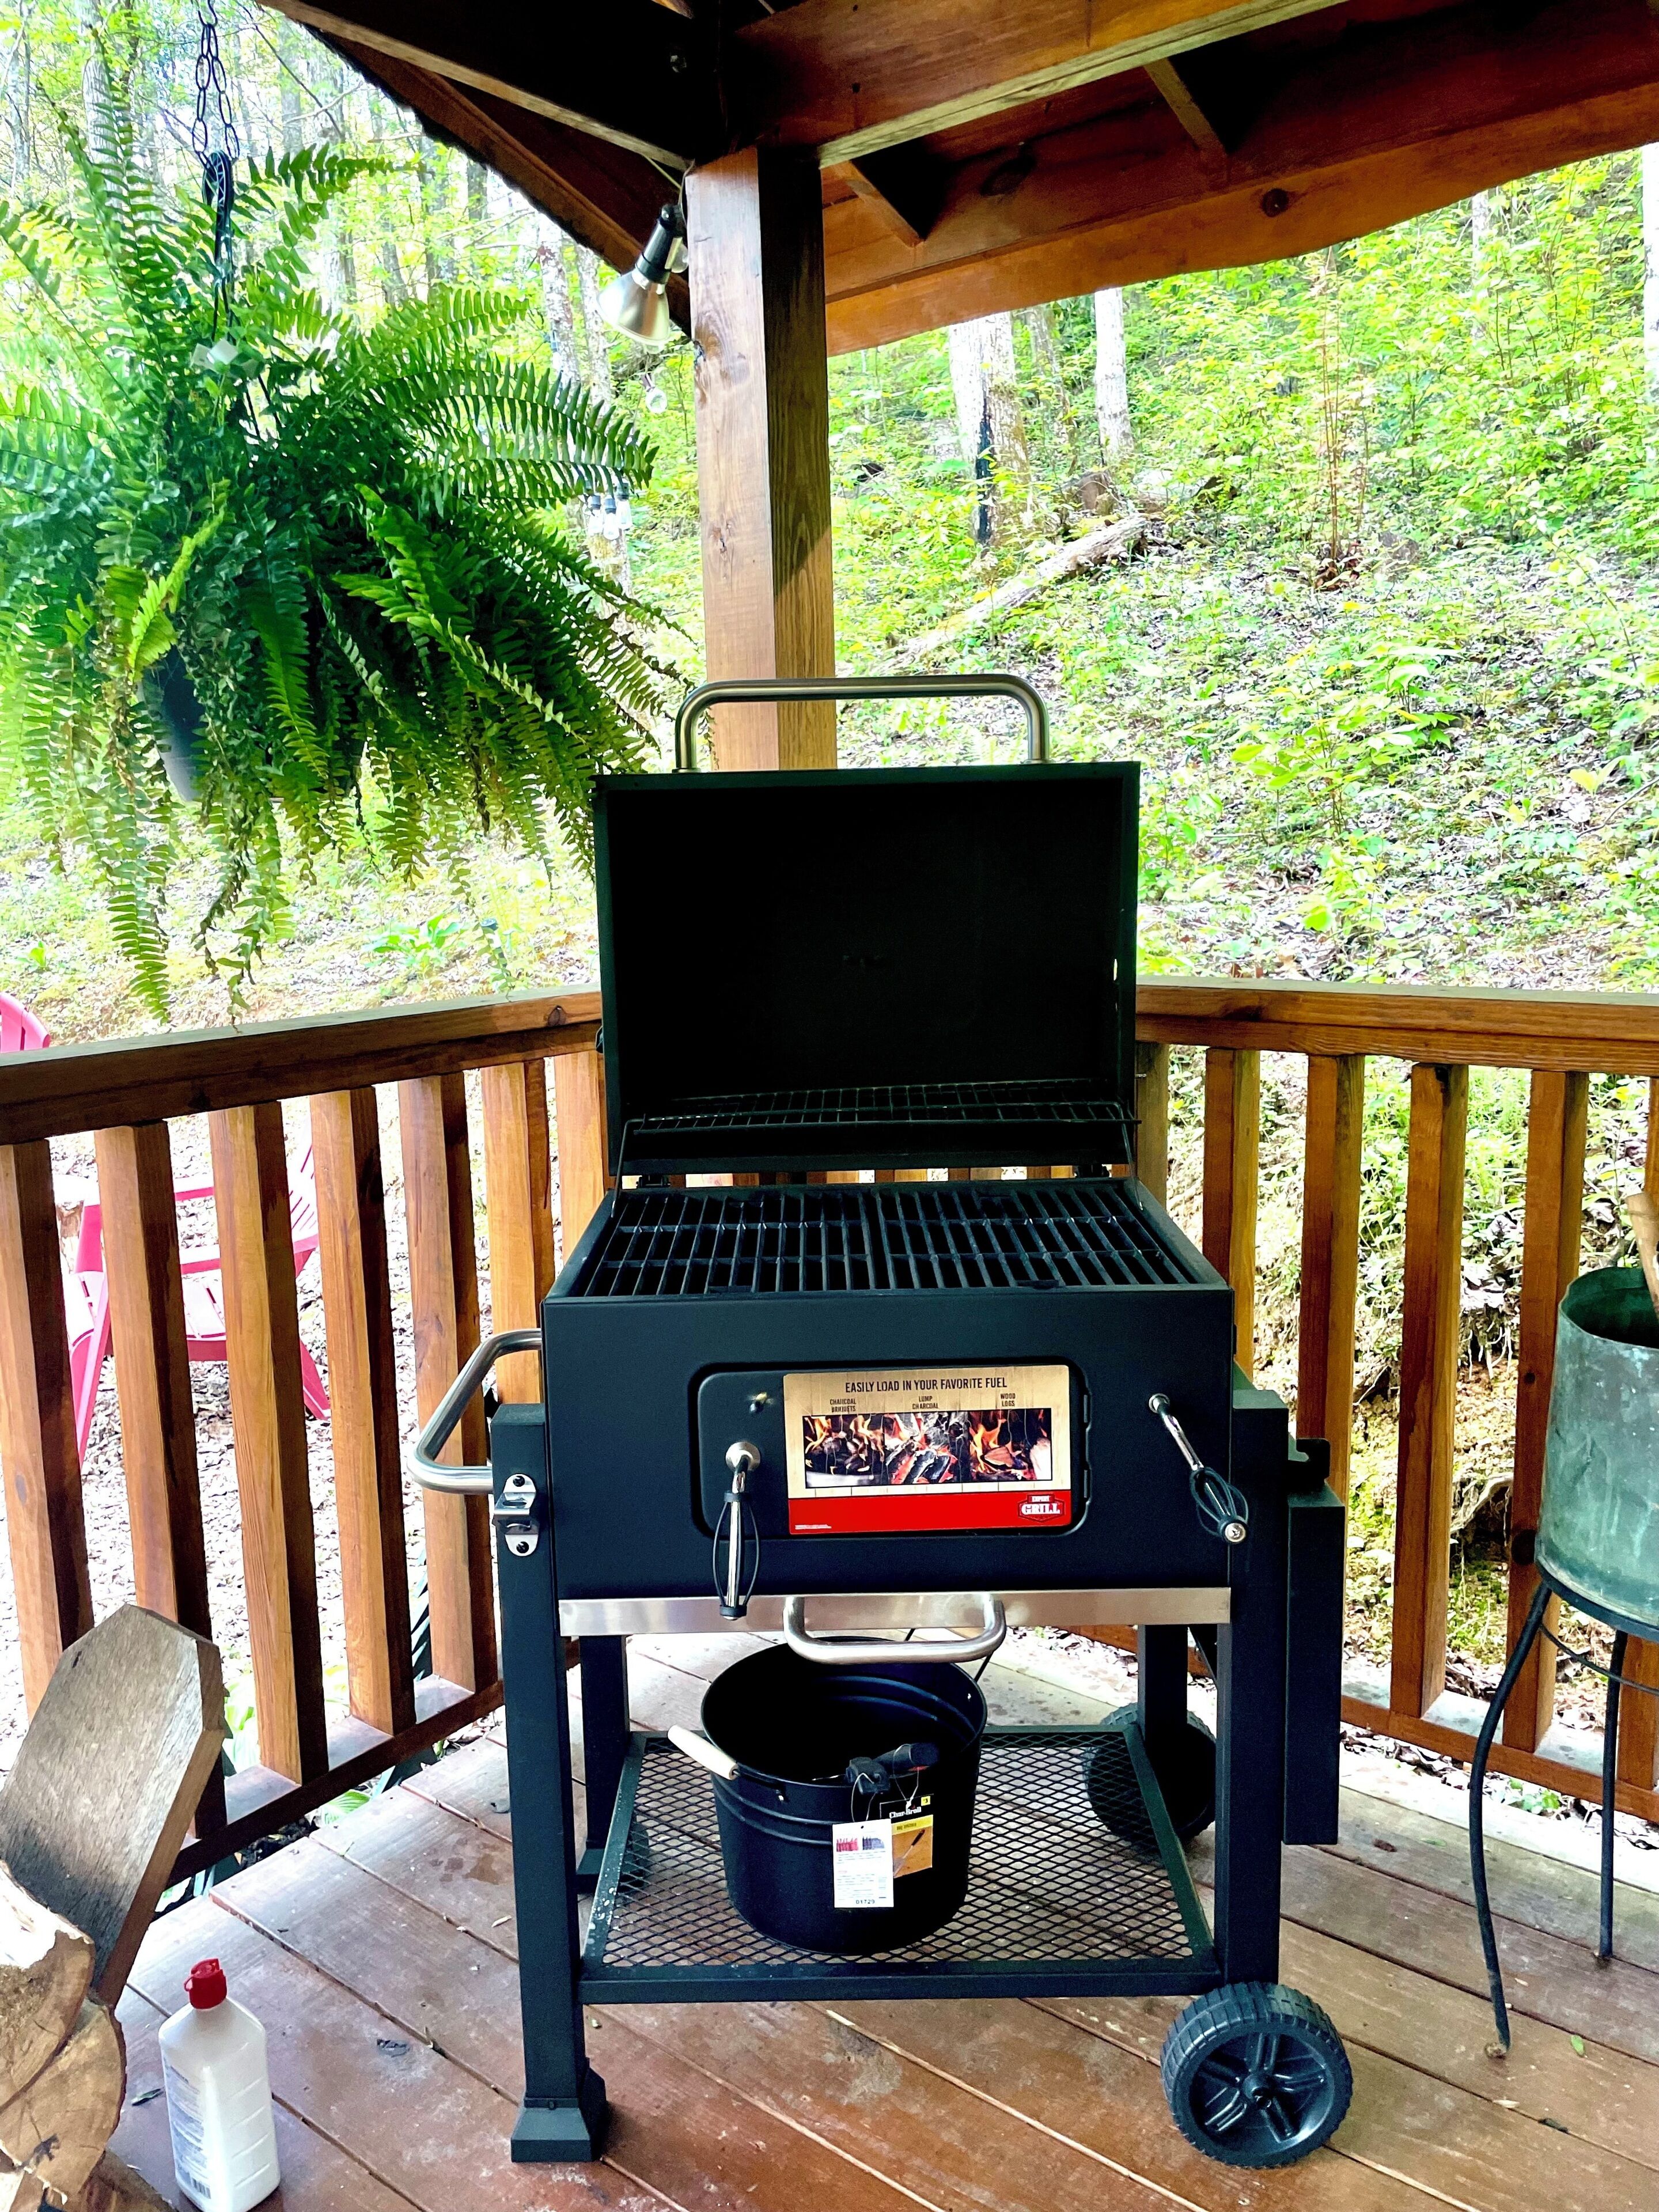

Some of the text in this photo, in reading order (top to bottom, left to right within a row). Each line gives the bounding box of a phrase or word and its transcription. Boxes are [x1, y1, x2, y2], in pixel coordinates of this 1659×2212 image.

[846, 1377, 1007, 1392] EASILY LOAD IN YOUR FAVORITE FUEL
[1021, 1503, 1060, 1515] GRILL
